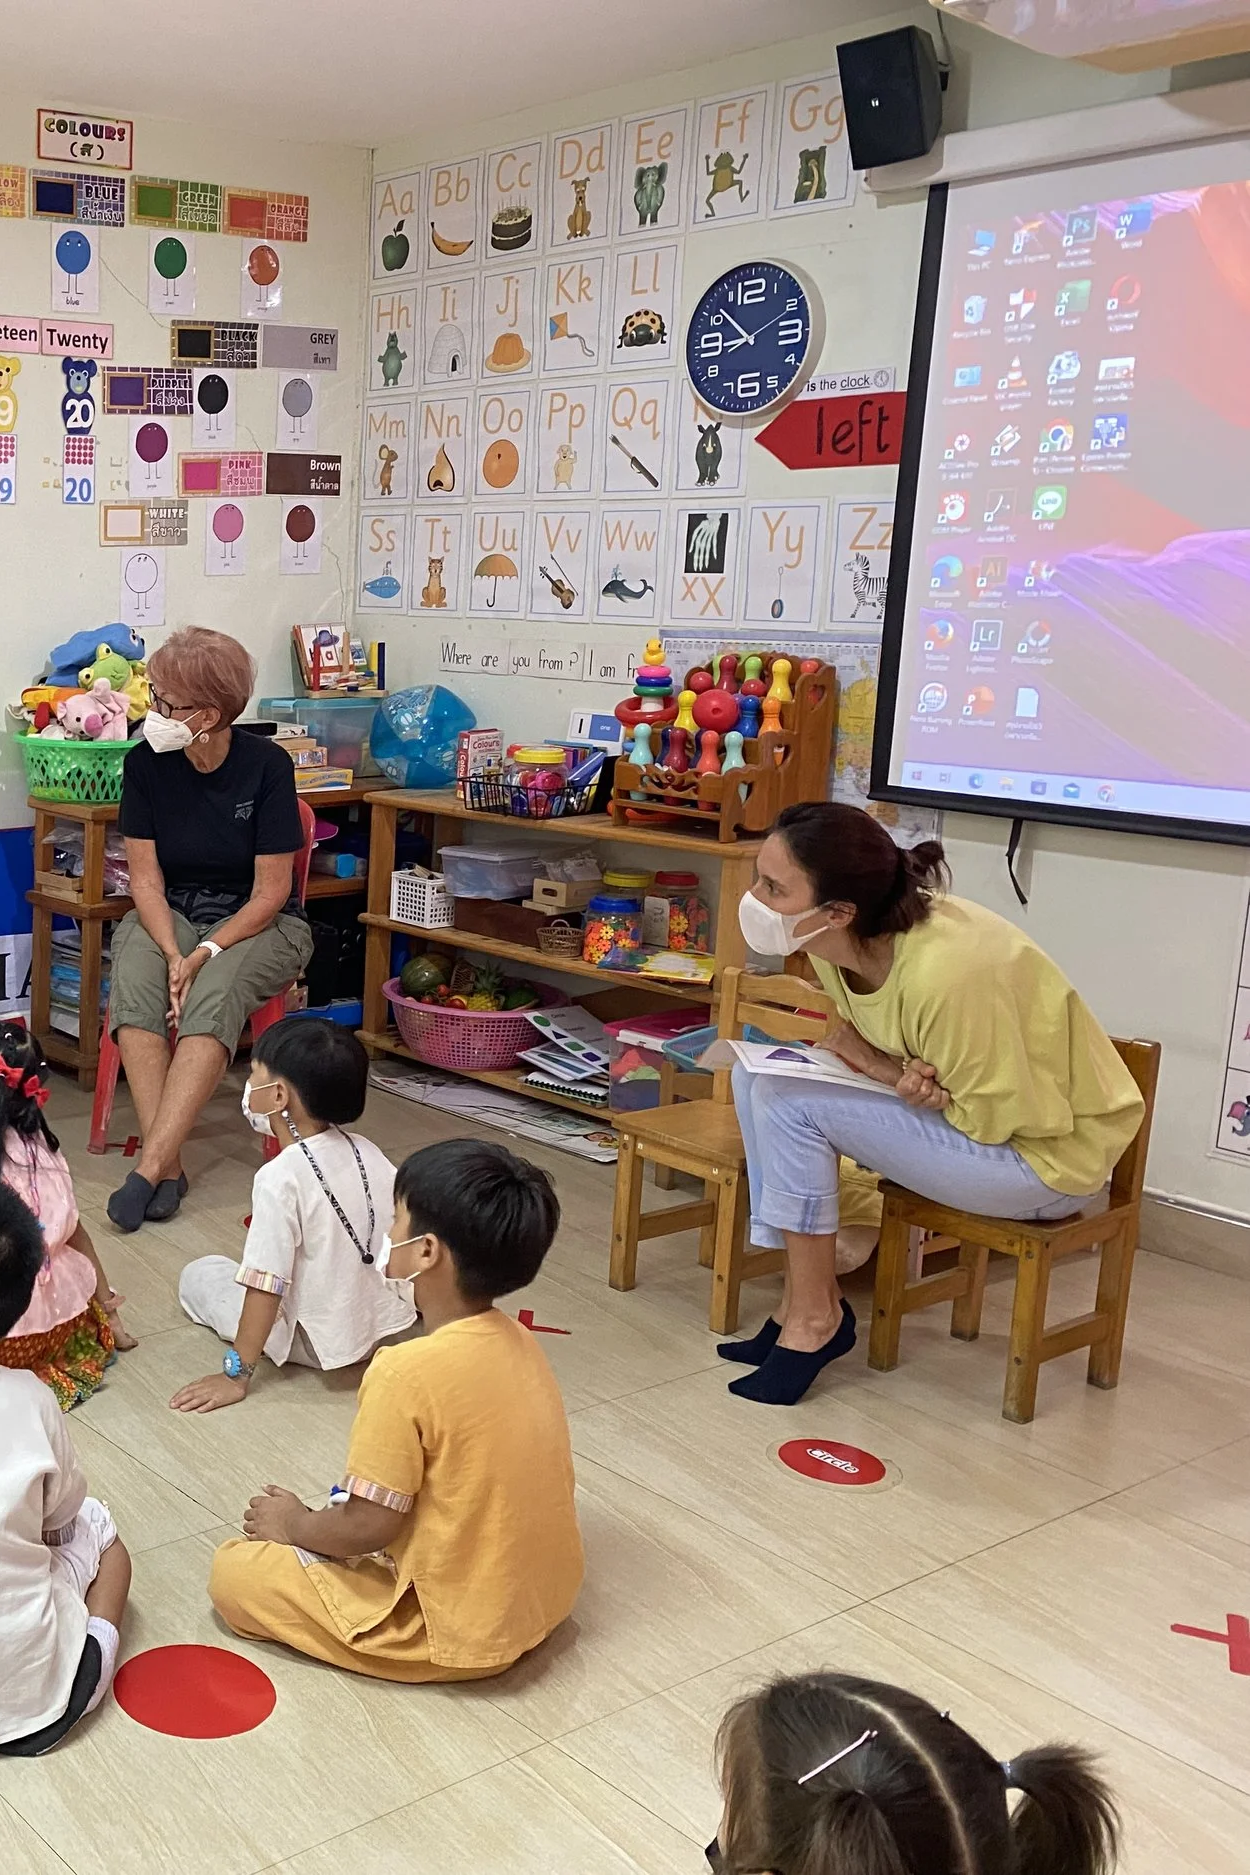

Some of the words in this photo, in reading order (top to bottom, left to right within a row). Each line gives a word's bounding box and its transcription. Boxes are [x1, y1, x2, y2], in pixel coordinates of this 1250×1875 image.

[44, 117, 127, 142] COLOURS
[714, 98, 755, 149] Ff
[558, 131, 606, 180] Dd
[635, 120, 674, 165] Ee
[495, 152, 532, 193] Cc
[84, 184, 120, 201] BLUE
[182, 190, 216, 206] GREEN
[377, 184, 415, 219] Aa
[434, 169, 471, 208] Bb
[270, 203, 308, 217] ORANGE
[1119, 213, 1133, 226] W
[1072, 217, 1091, 233] Ps
[555, 264, 593, 306] Kk
[737, 278, 766, 306] 12
[1060, 291, 1070, 303] X
[64, 296, 80, 307] blue
[376, 295, 411, 332] Hh
[439, 286, 458, 323] Ii
[496, 275, 519, 328] Jj
[785, 298, 798, 312] 2
[46, 328, 109, 354] Twenty
[220, 330, 258, 342] BLACK
[310, 333, 336, 345] GREY
[700, 331, 723, 358] 9
[778, 318, 802, 346] 3
[707, 365, 719, 378] 8
[784, 353, 796, 366] 4
[151, 378, 190, 389] PURPLE
[722, 382, 735, 394] 7
[737, 372, 761, 398] 6
[766, 375, 779, 389] 5
[806, 381, 816, 392] is
[820, 377, 837, 391] the
[840, 374, 873, 390] clock.
[65, 398, 95, 429] 20
[368, 411, 407, 440] Mm
[423, 403, 462, 440] Nn
[483, 397, 523, 434] Oo
[547, 392, 586, 444] Pp
[611, 387, 660, 441] Qq
[815, 400, 891, 463] left
[228, 459, 253, 471] PINK
[310, 459, 342, 472] Brown
[65, 477, 93, 502] 20
[149, 507, 185, 519] WHITE
[151, 523, 181, 538] สีขาว
[368, 518, 396, 552] Ss
[424, 518, 452, 553] Tt
[479, 515, 518, 553] Uu
[544, 516, 582, 553] Vv
[604, 519, 657, 551] Ww
[762, 511, 805, 570] Yy
[849, 507, 893, 553] Zz
[979, 626, 995, 642] Lr
[441, 641, 472, 668] Where
[481, 655, 499, 668] are
[512, 655, 530, 675] you
[588, 649, 594, 676] I
[599, 663, 616, 678] am
[472, 739, 501, 751] Colours
[808, 1448, 857, 1474] Circle
